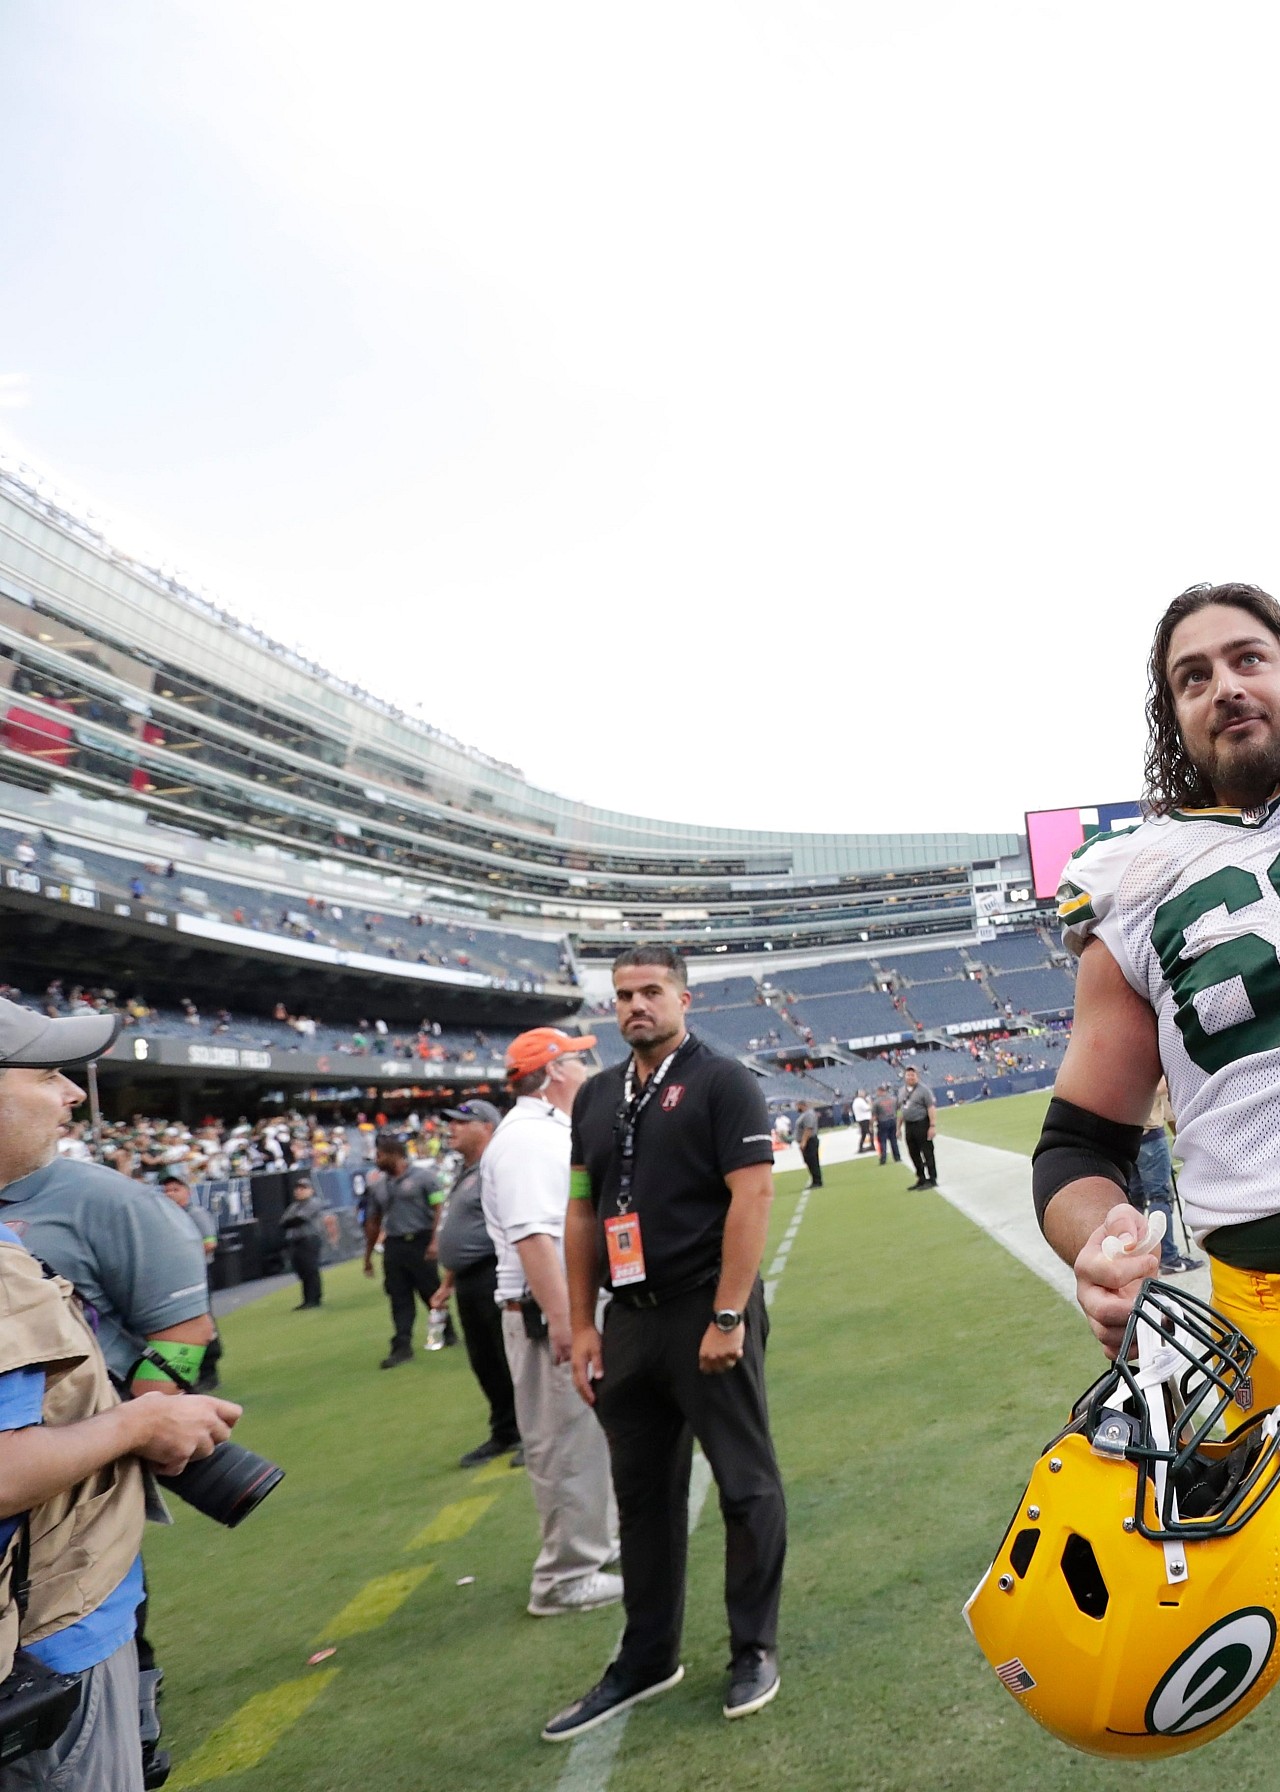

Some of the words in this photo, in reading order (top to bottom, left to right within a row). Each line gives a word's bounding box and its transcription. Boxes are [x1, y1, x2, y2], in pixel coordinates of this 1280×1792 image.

[849, 1033, 902, 1050] BEAR
[947, 1019, 1000, 1035] DOWN
[188, 1044, 239, 1066] SOLDIER
[240, 1050, 272, 1069] FIELD
